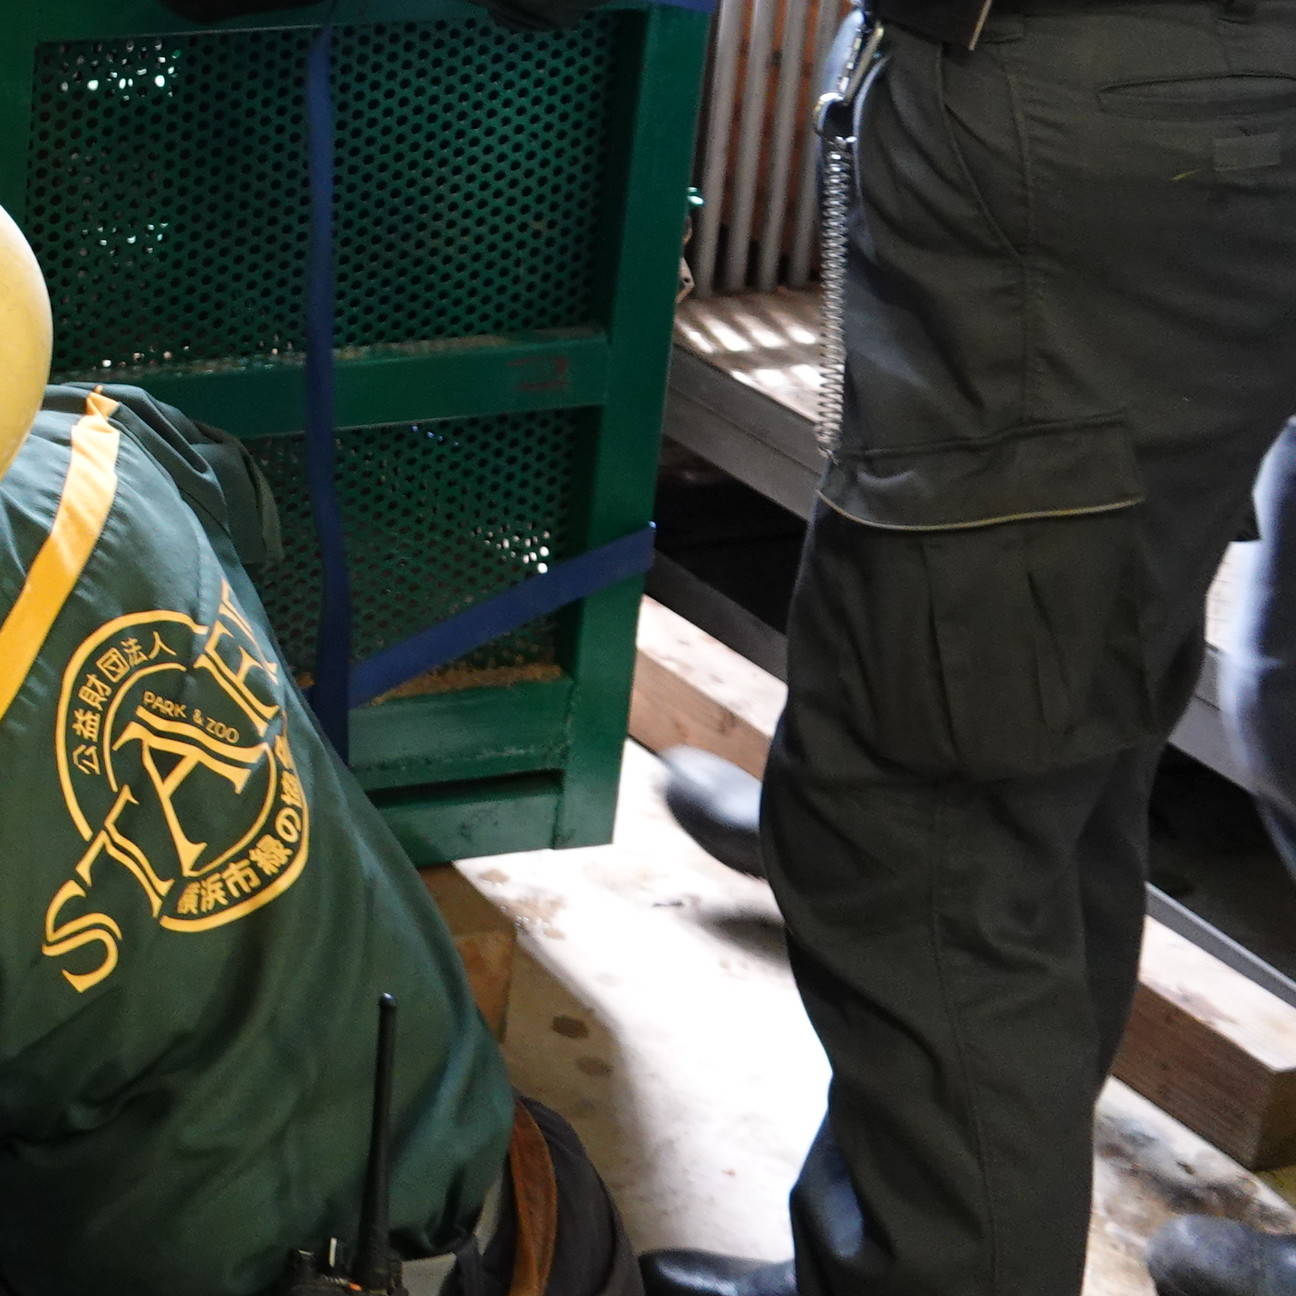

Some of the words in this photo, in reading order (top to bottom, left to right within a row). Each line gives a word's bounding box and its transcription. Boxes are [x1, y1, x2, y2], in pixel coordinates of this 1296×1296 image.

[72, 631, 177, 776] 公益財団法人
[143, 690, 188, 719] PARK
[192, 708, 205, 727] &
[205, 716, 241, 745] ZOO
[42, 576, 280, 994] STAFF
